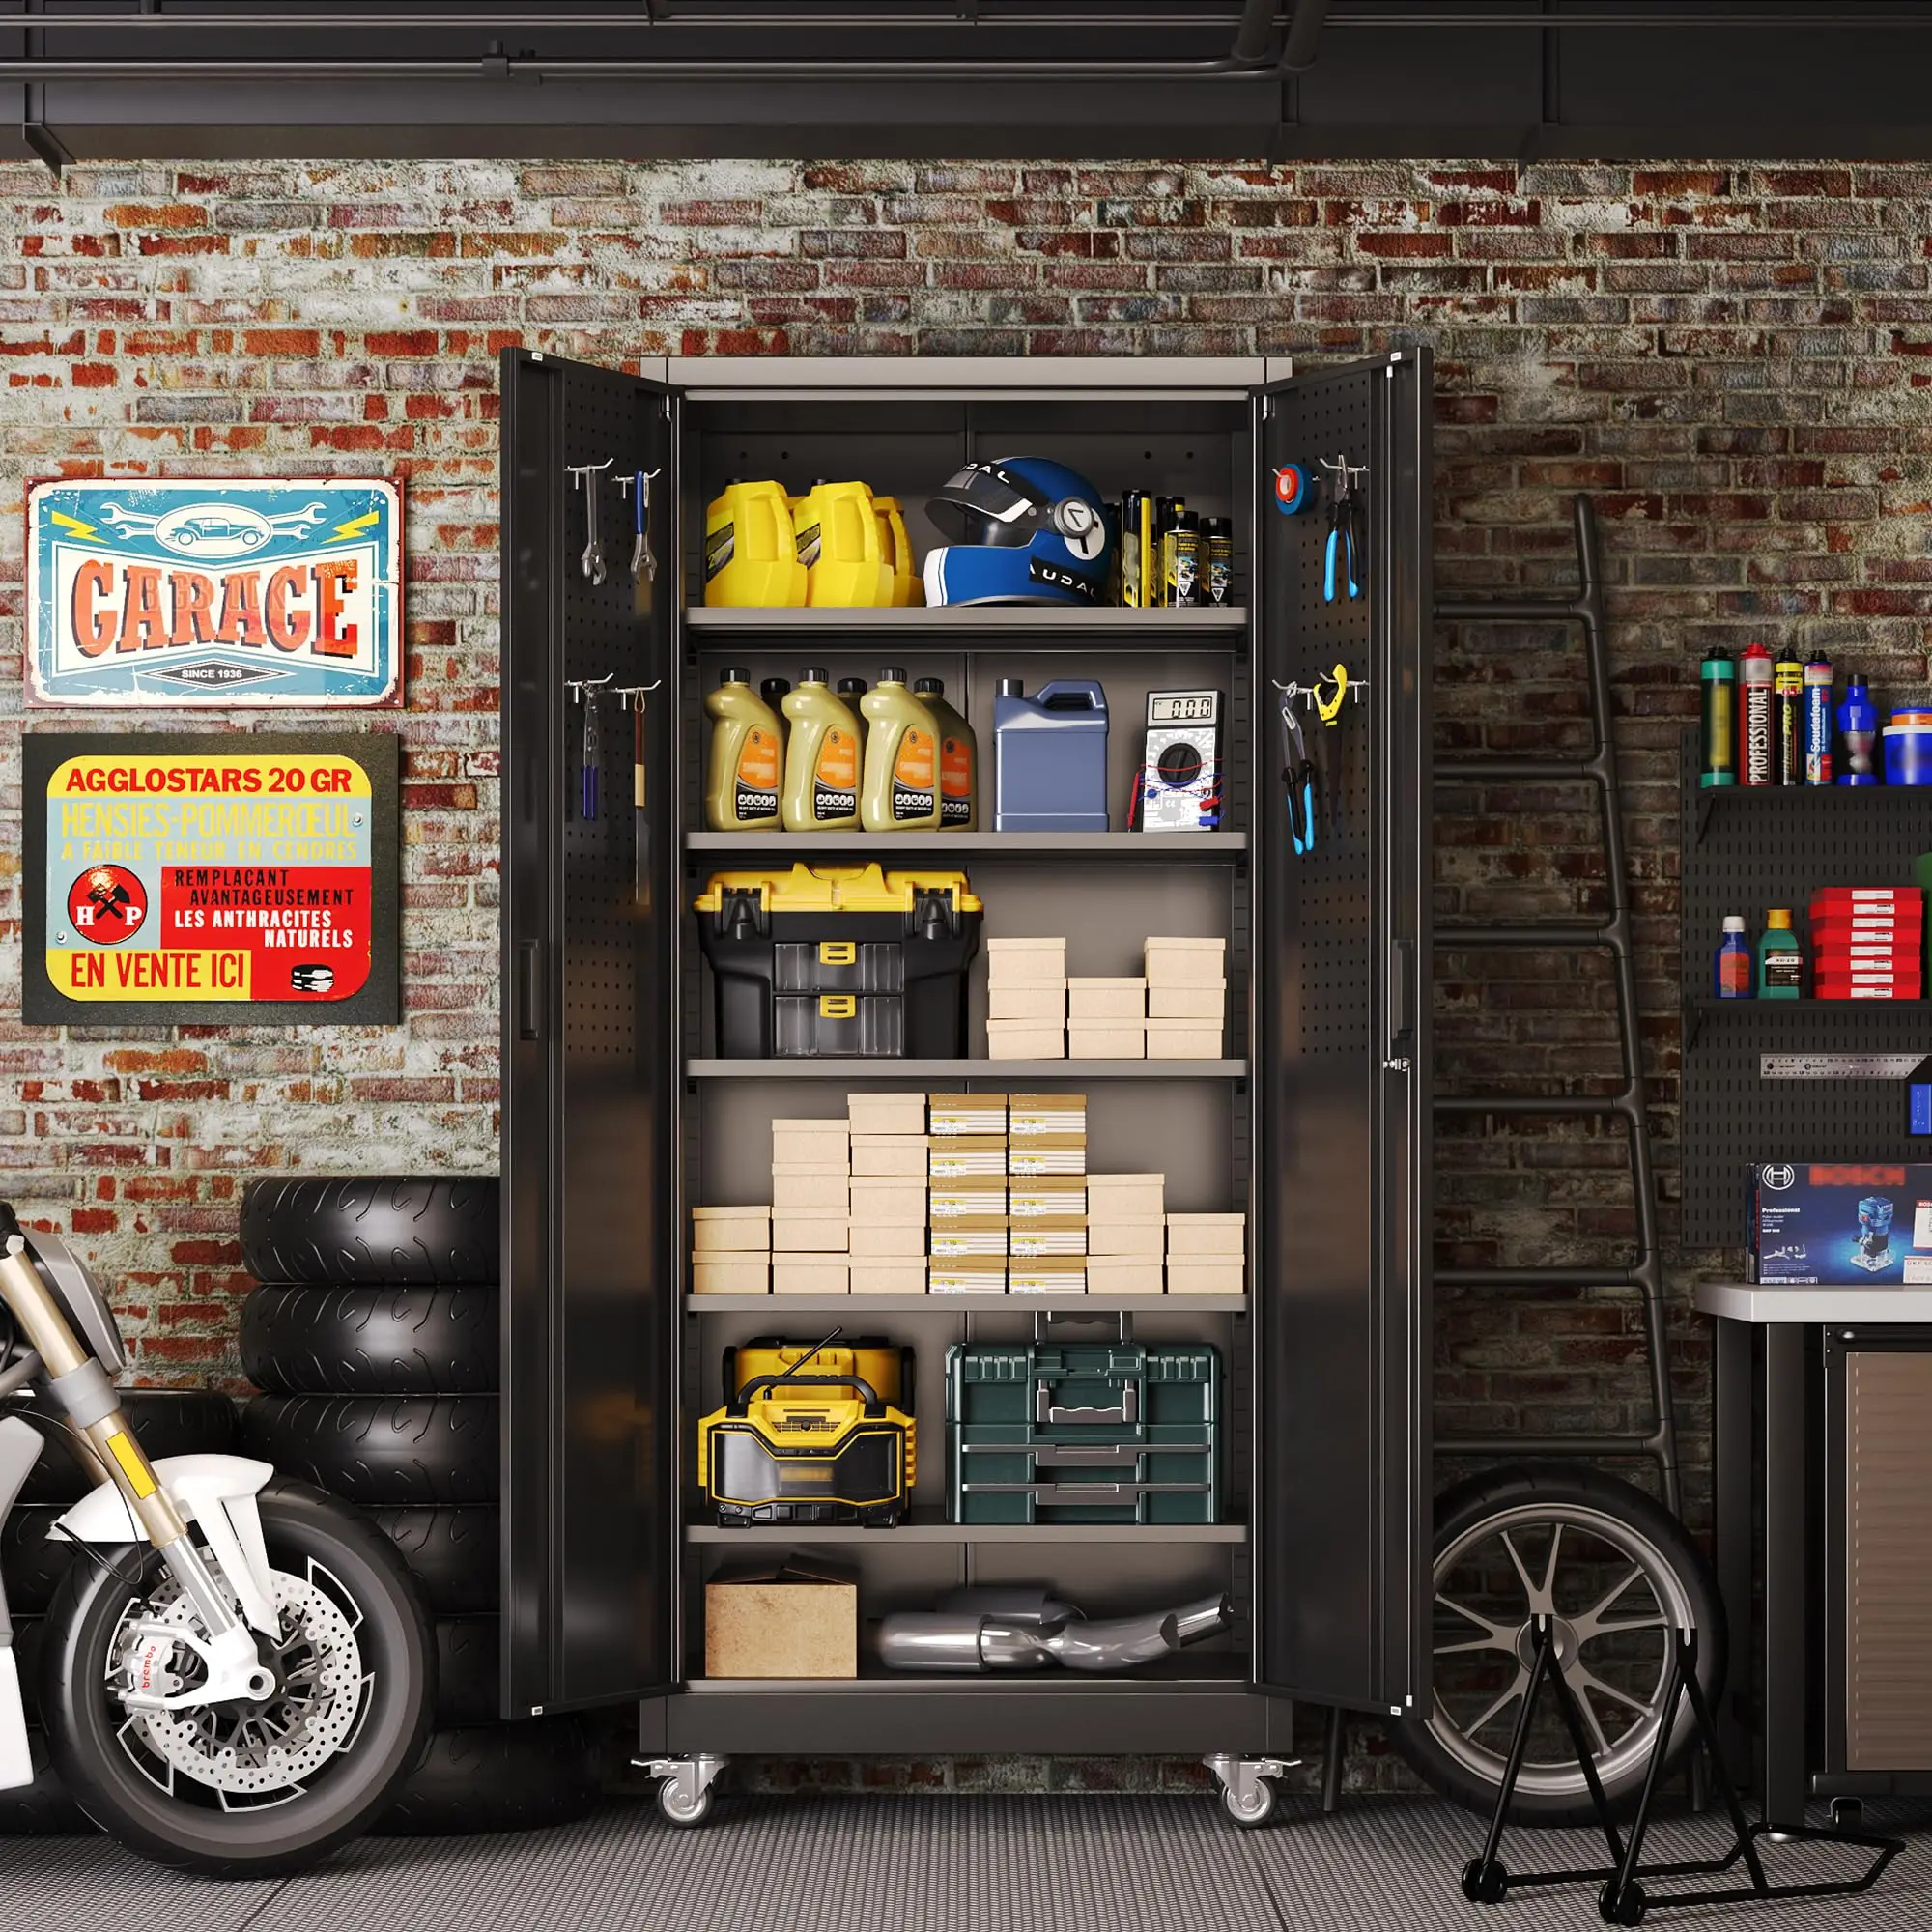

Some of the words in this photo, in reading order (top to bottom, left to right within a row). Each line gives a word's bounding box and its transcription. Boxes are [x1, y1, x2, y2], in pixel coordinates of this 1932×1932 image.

[71, 559, 358, 659] GARAGE
[181, 669, 214, 679] SINCE
[217, 669, 242, 679] 1936
[1749, 689, 1767, 783] PROFESSIONAL
[66, 768, 262, 793] AGGLOSTARS
[268, 768, 305, 793] 20
[311, 768, 352, 793] GR
[82, 841, 143, 860] FAIBLE
[156, 842, 226, 861] TENEUR
[238, 842, 262, 860] EN
[272, 841, 356, 861] CENDRES
[189, 889, 354, 906] AVANTAGEUSEMENT
[76, 906, 95, 926] H
[125, 906, 142, 926] P
[175, 910, 205, 928] LES
[213, 910, 332, 928] ANTHRACITES
[264, 928, 353, 948] NATURELS
[71, 953, 109, 988] EN
[115, 952, 202, 988] VENTE
[212, 952, 244, 988] ICI
[142, 1646, 156, 1689] brembo
